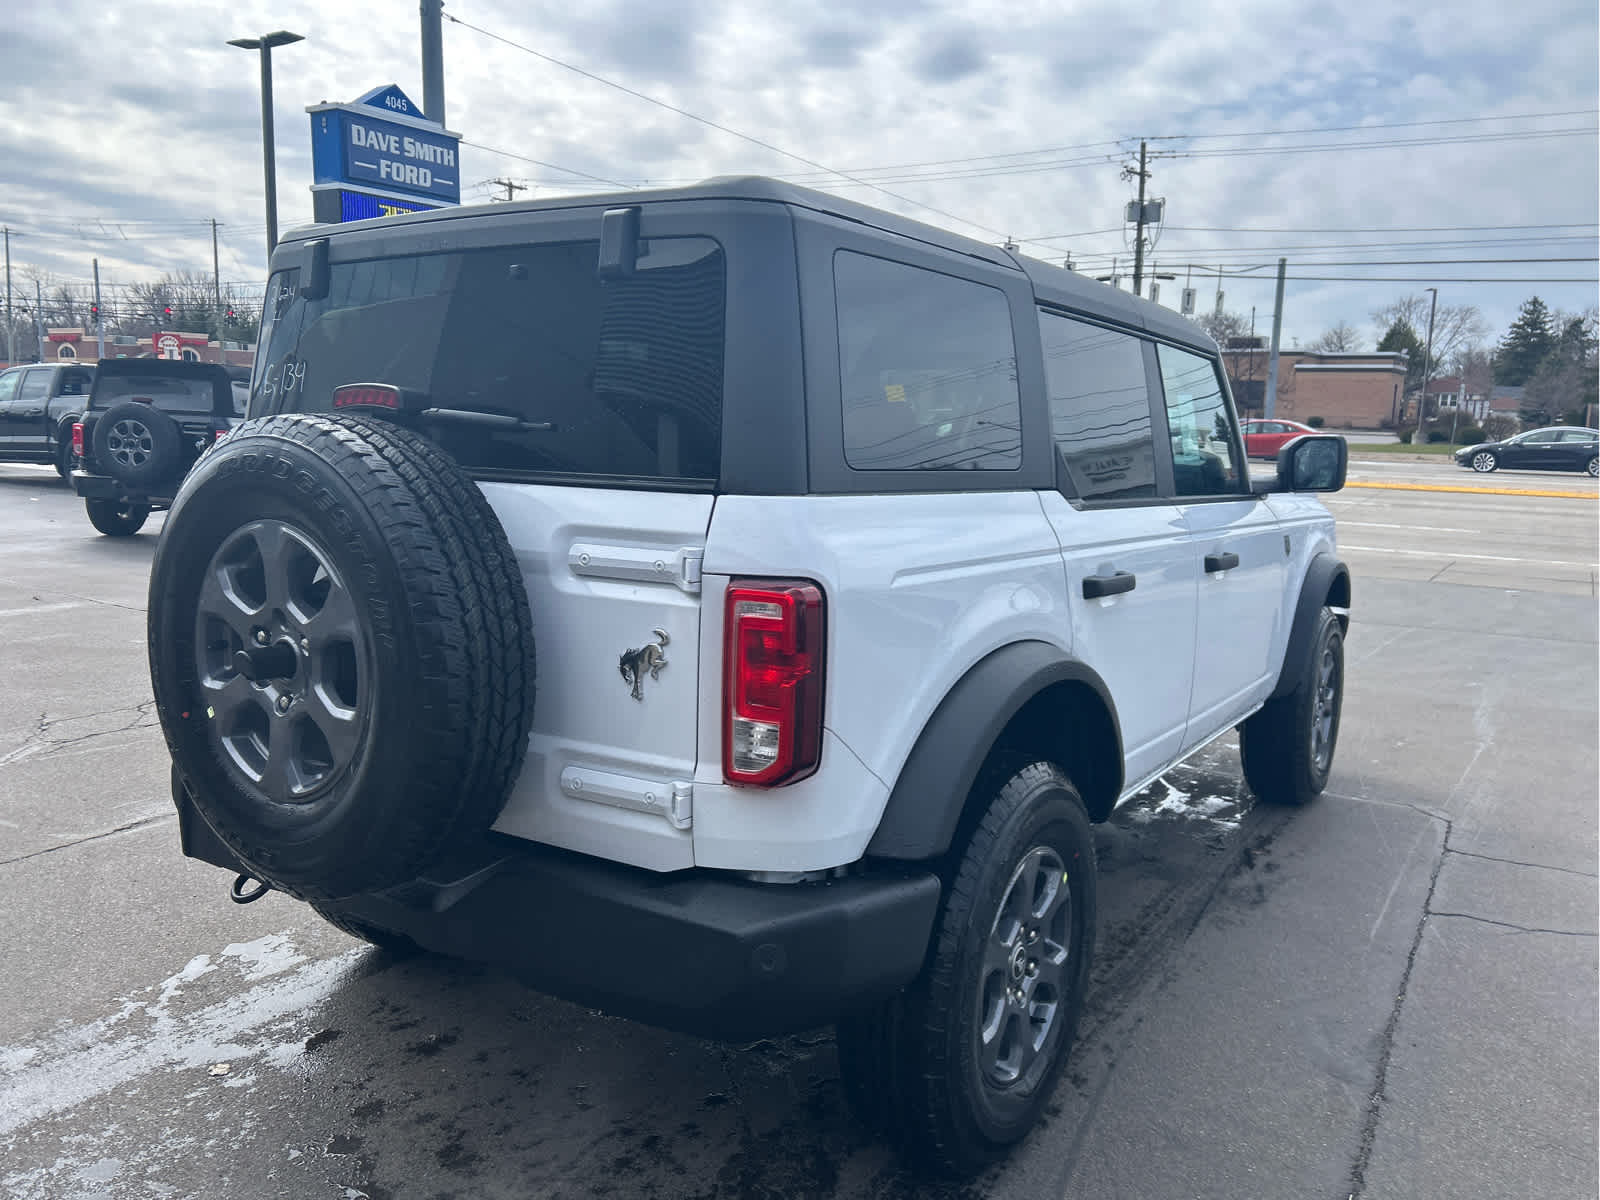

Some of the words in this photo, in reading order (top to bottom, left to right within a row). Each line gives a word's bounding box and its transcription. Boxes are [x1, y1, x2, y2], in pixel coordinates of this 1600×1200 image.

[384, 95, 408, 112] 4045
[351, 124, 400, 154] DAVE
[403, 137, 455, 168] SMITH
[379, 159, 431, 187] FORD
